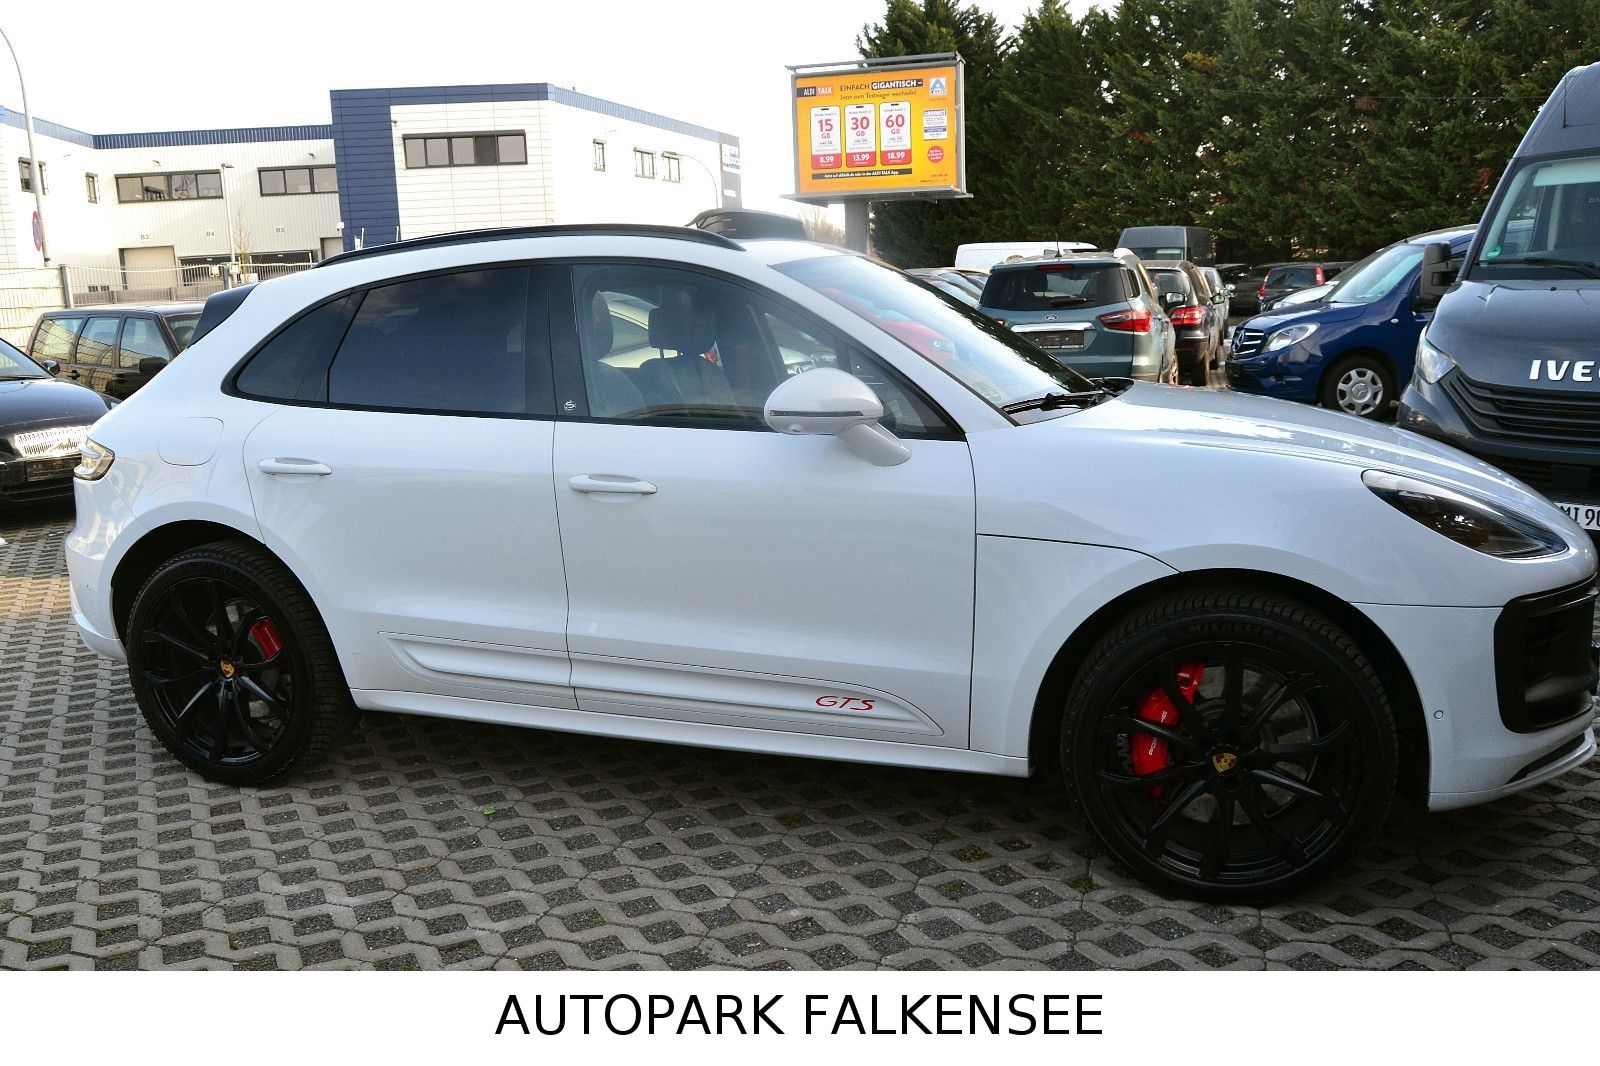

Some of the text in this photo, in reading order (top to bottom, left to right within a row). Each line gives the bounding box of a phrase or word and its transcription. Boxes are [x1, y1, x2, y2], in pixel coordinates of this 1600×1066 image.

[803, 87, 833, 96] ALDI TALK
[840, 83, 870, 91] EINFACH
[872, 79, 917, 90] GIGANTISCH
[817, 118, 834, 132] 15
[850, 116, 870, 130] 30
[885, 114, 905, 128] 60
[819, 156, 834, 164] 8.99
[852, 153, 870, 161] 13.99
[887, 151, 906, 160] 18.99
[1529, 360, 1600, 381] IVE
[816, 695, 876, 711] GTS
